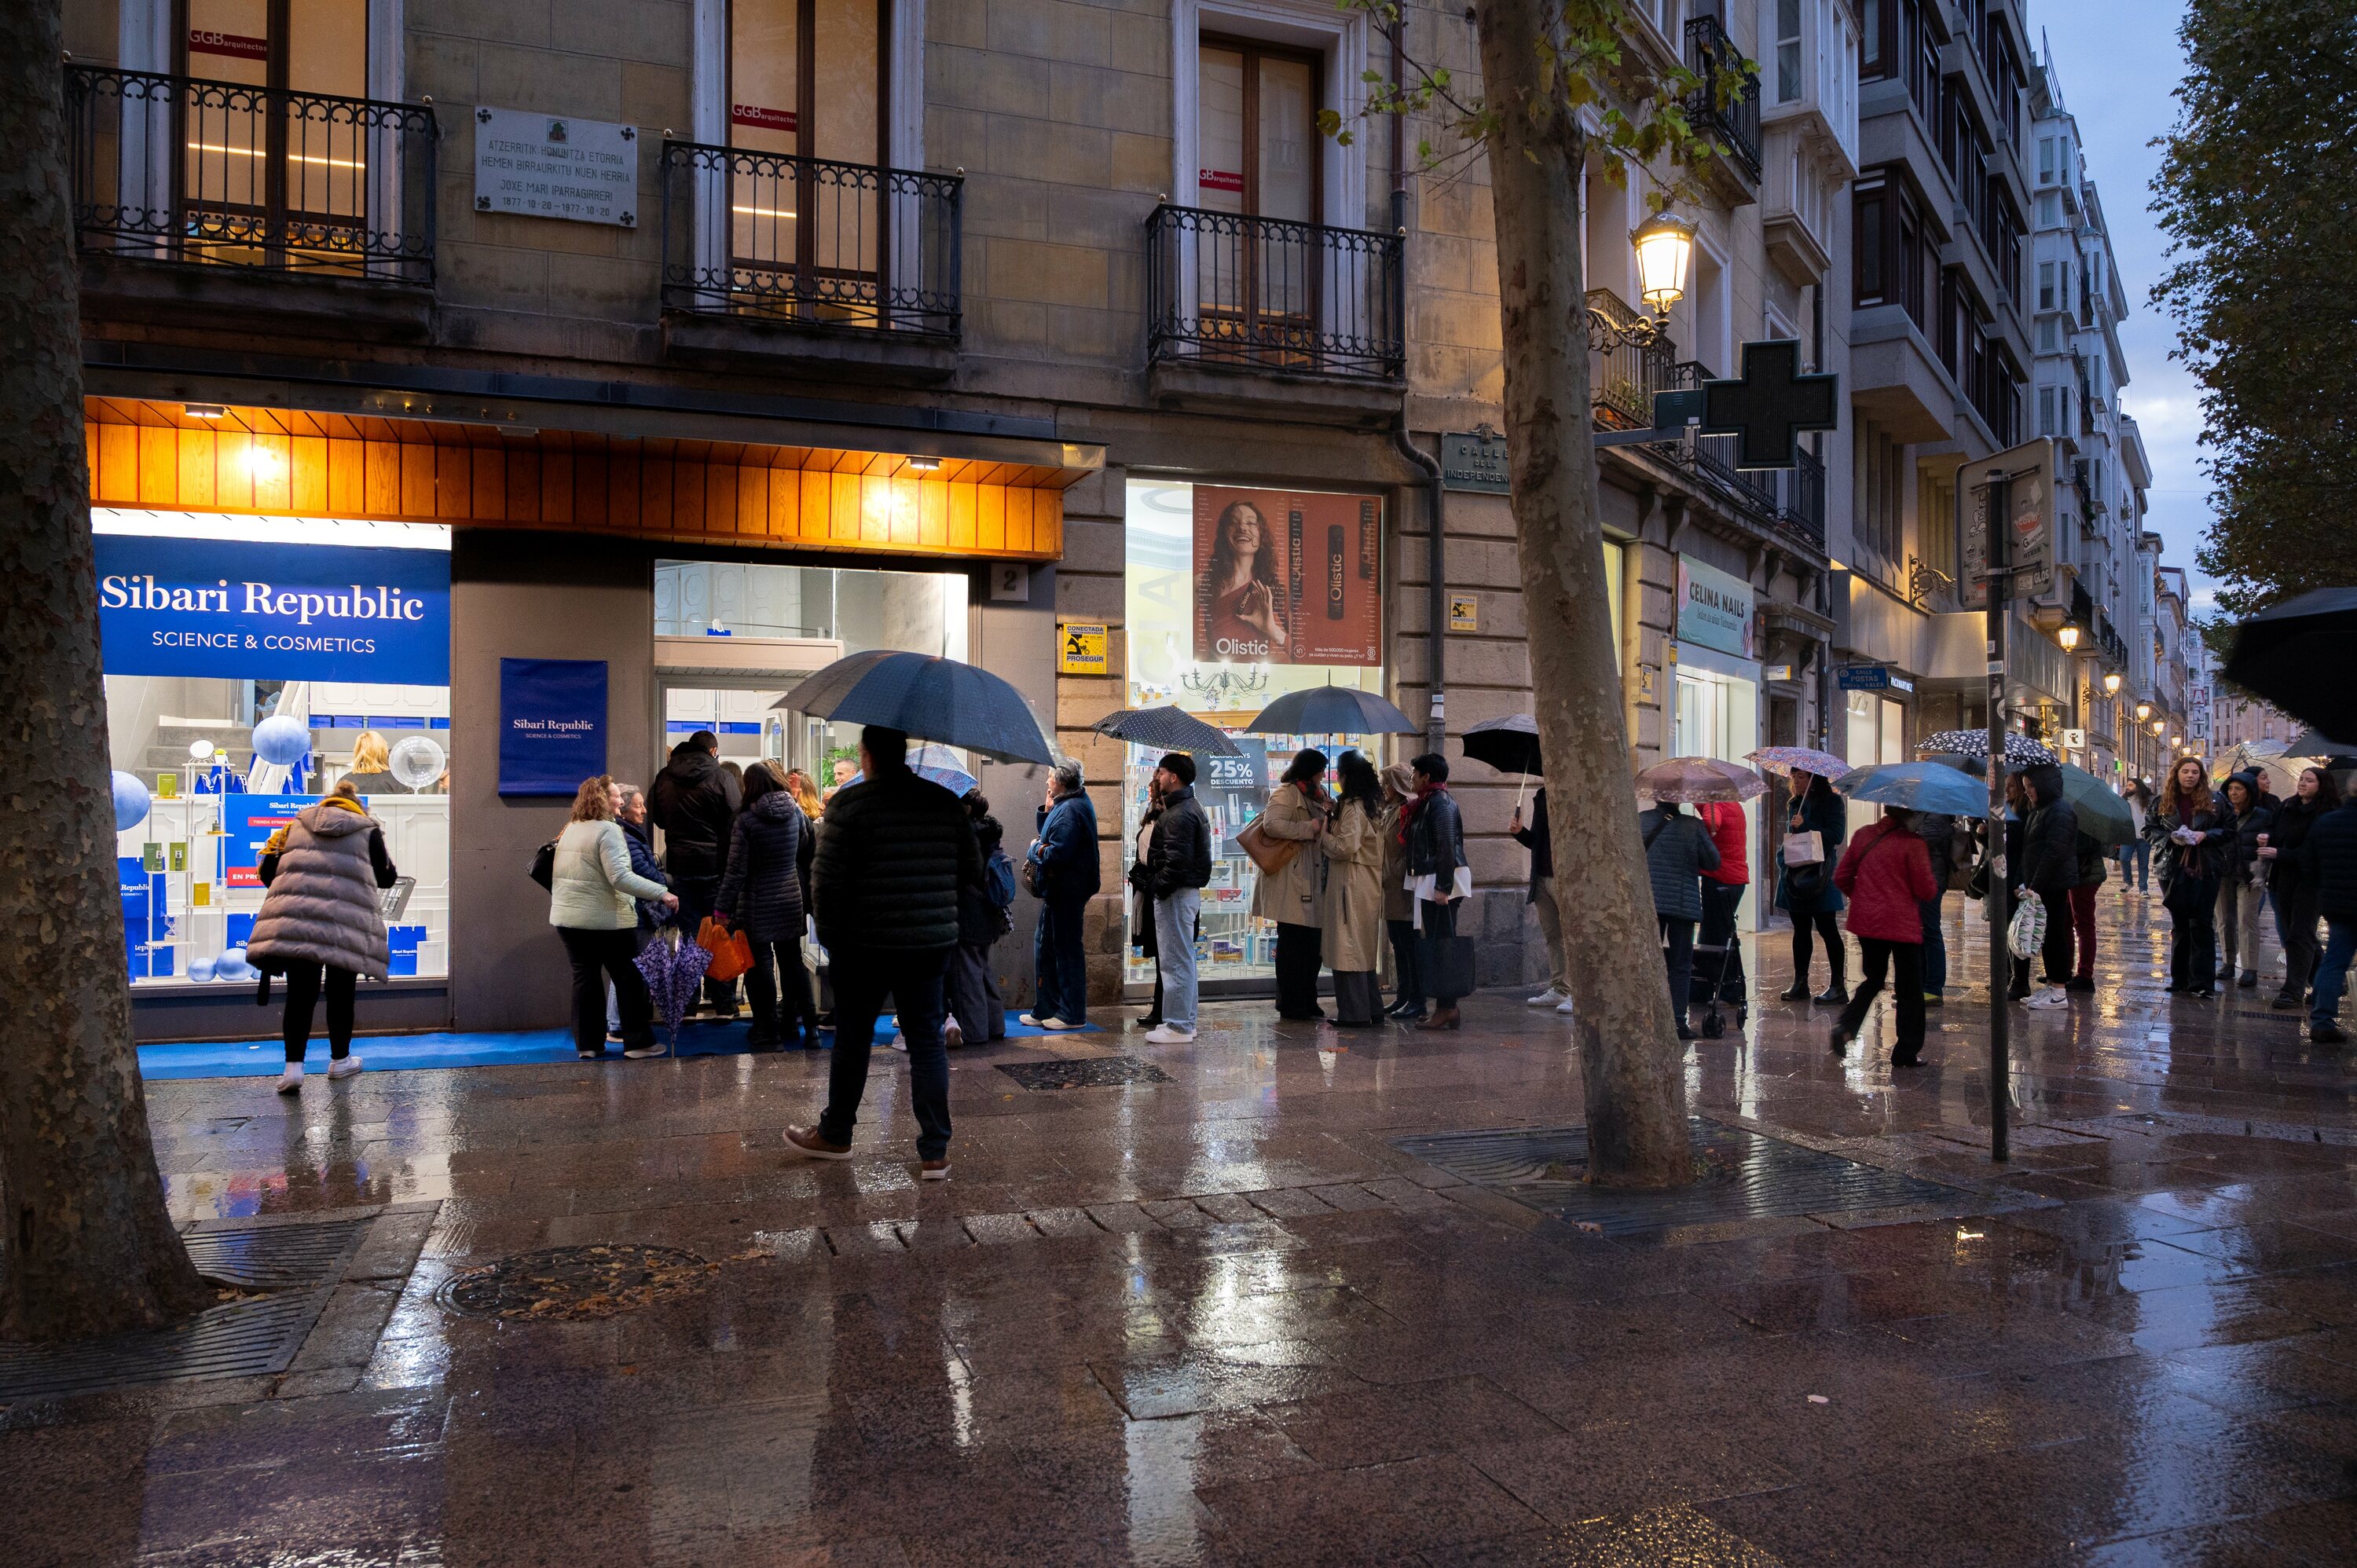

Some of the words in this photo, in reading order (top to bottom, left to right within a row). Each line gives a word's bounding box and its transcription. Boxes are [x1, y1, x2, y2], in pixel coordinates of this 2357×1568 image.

[224, 40, 267, 52] arquitectos
[761, 113, 797, 123] arquitectos
[589, 152, 624, 166] ETORRIA
[482, 156, 513, 170] HEMEN
[516, 160, 572, 177] BIRRAURKITU
[575, 167, 597, 180] NUEN
[600, 170, 630, 183] HERRIA
[500, 180, 522, 192] JOXE
[526, 183, 548, 195] MARI
[552, 185, 613, 202] IPARRAGIRRERI
[1461, 445, 1508, 458] CALLE
[1446, 469, 1508, 482] INDEPENDEN
[1003, 570, 1017, 592] 2
[1330, 554, 1342, 601] Olistic
[101, 573, 230, 612] Sibari
[241, 581, 425, 625] Republic
[1689, 581, 1719, 610] CELINA
[1722, 595, 1745, 619] NAILS
[152, 631, 238, 649] SCIENCE
[244, 635, 258, 649] &
[264, 636, 376, 654] COSMETICS
[1215, 637, 1268, 656] Olistic
[513, 719, 544, 729] Sibari
[548, 720, 593, 731] Republic
[1209, 760, 1253, 778] 25%
